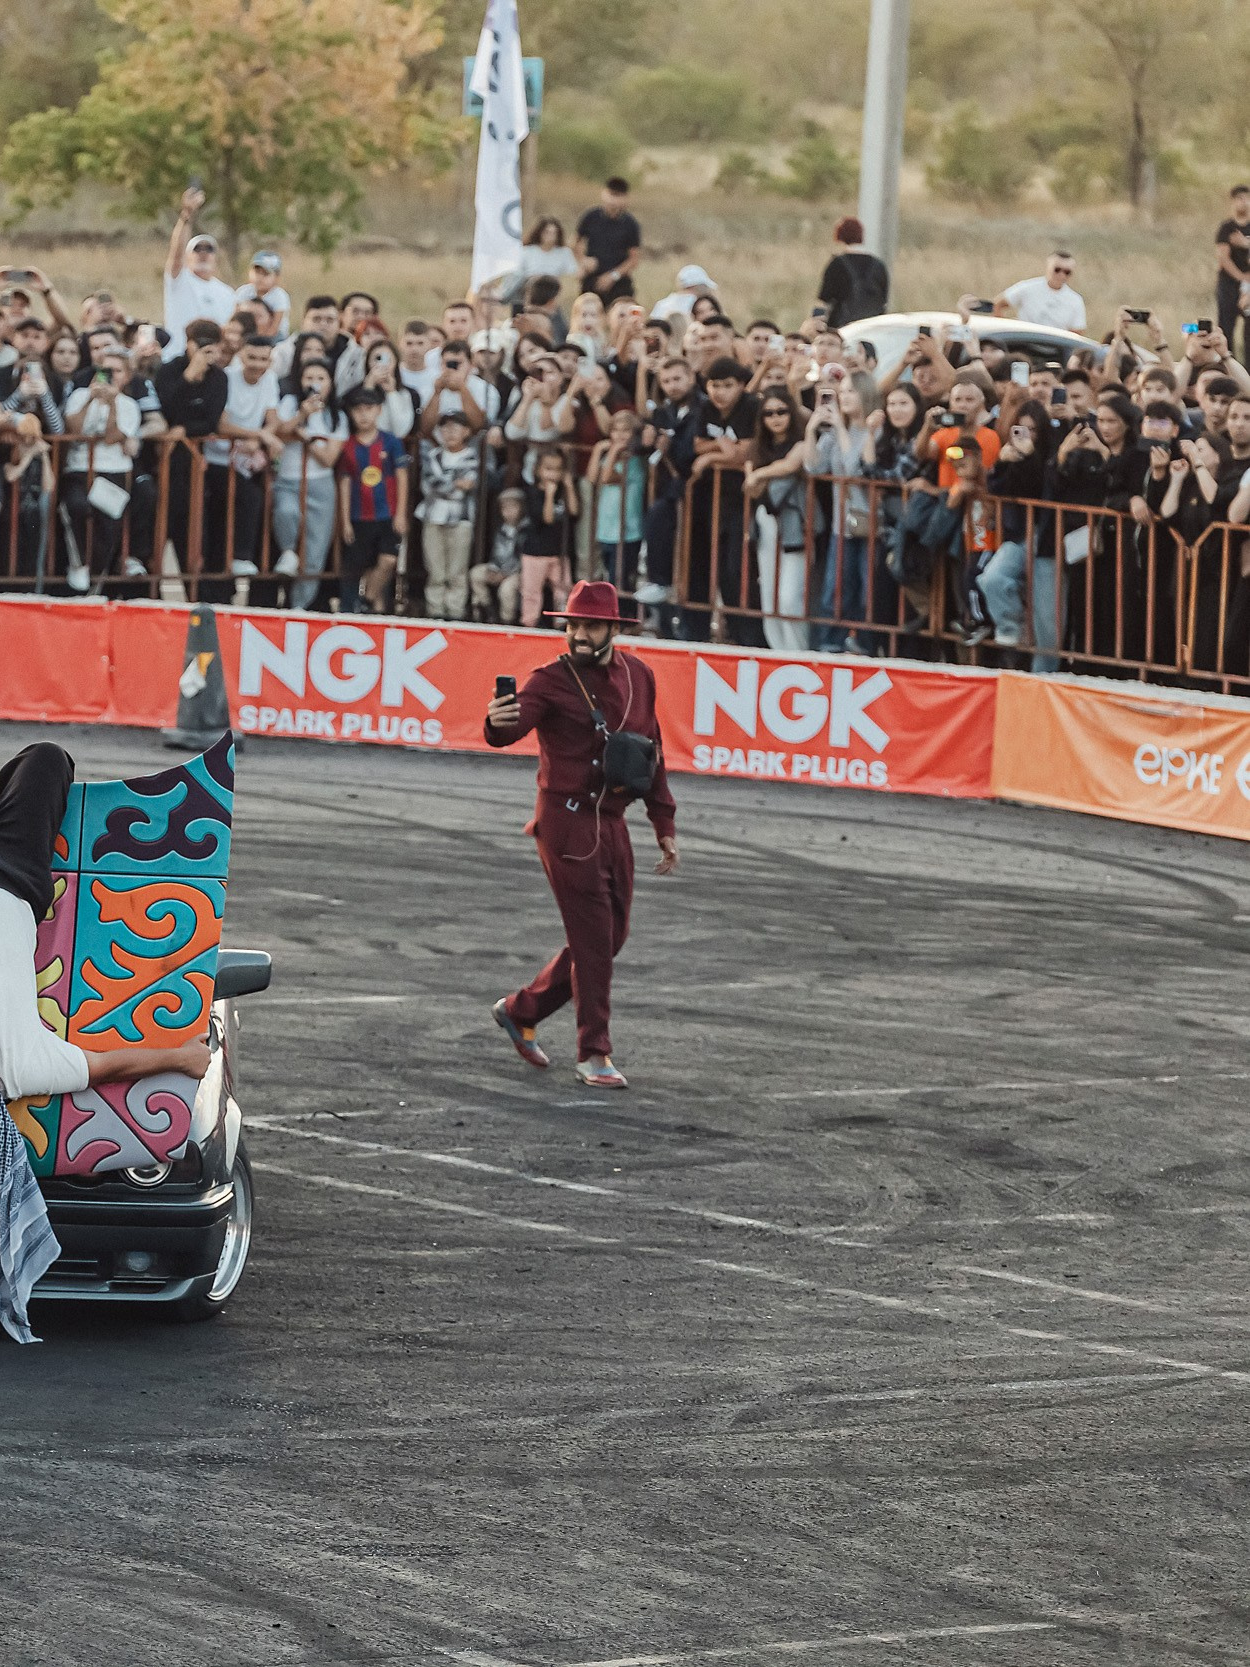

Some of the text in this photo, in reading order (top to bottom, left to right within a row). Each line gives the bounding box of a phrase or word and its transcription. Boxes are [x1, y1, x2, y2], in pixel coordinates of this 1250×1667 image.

[238, 620, 448, 712] NGK
[238, 705, 443, 745] SPARK PLUGS
[693, 657, 892, 754] NGK
[692, 745, 889, 786] SPARK PLUGS
